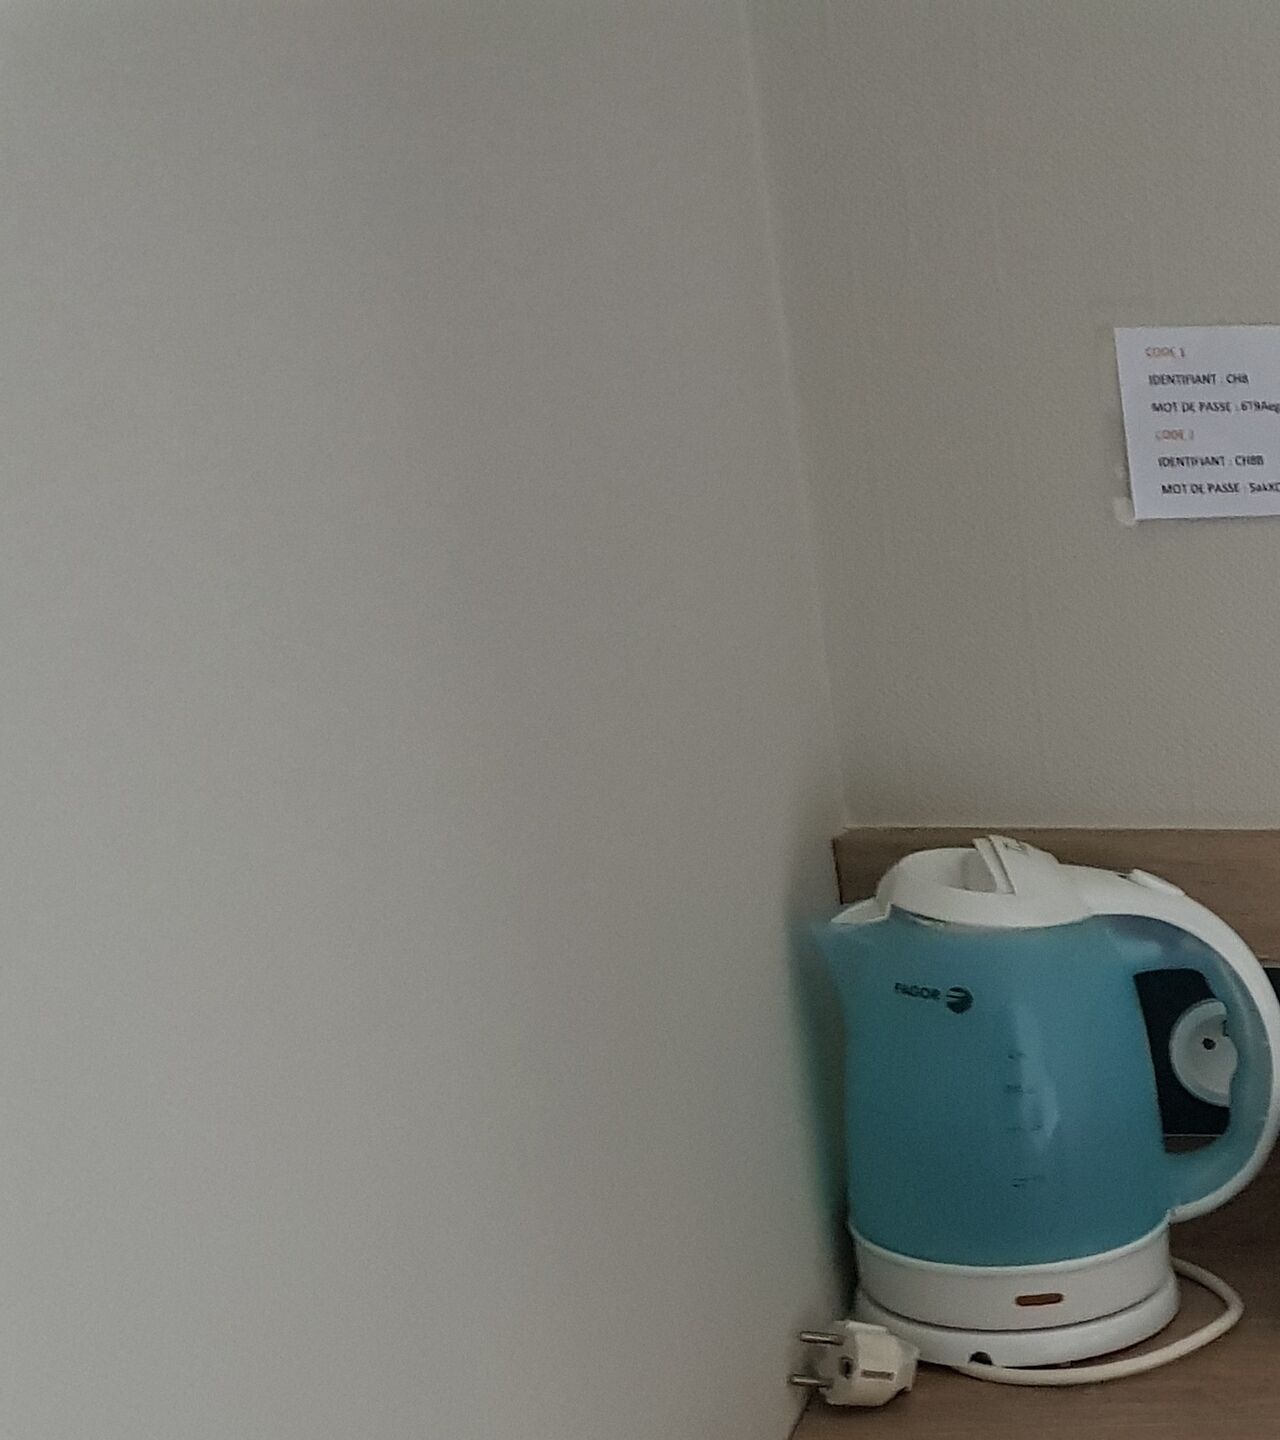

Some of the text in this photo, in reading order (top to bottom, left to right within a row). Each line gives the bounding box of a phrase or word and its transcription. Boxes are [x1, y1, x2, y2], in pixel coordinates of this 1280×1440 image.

[1147, 373, 1217, 386] IDENTIFIANT
[1151, 401, 1179, 413] MOT
[1182, 401, 1197, 413] DE
[1199, 401, 1232, 413] PASSE
[1158, 455, 1225, 468] IDENTIFIANT
[1161, 483, 1187, 495] MOT
[1191, 482, 1205, 495] DE
[1207, 482, 1240, 494] PASSE
[895, 982, 941, 1001] FAGOR
